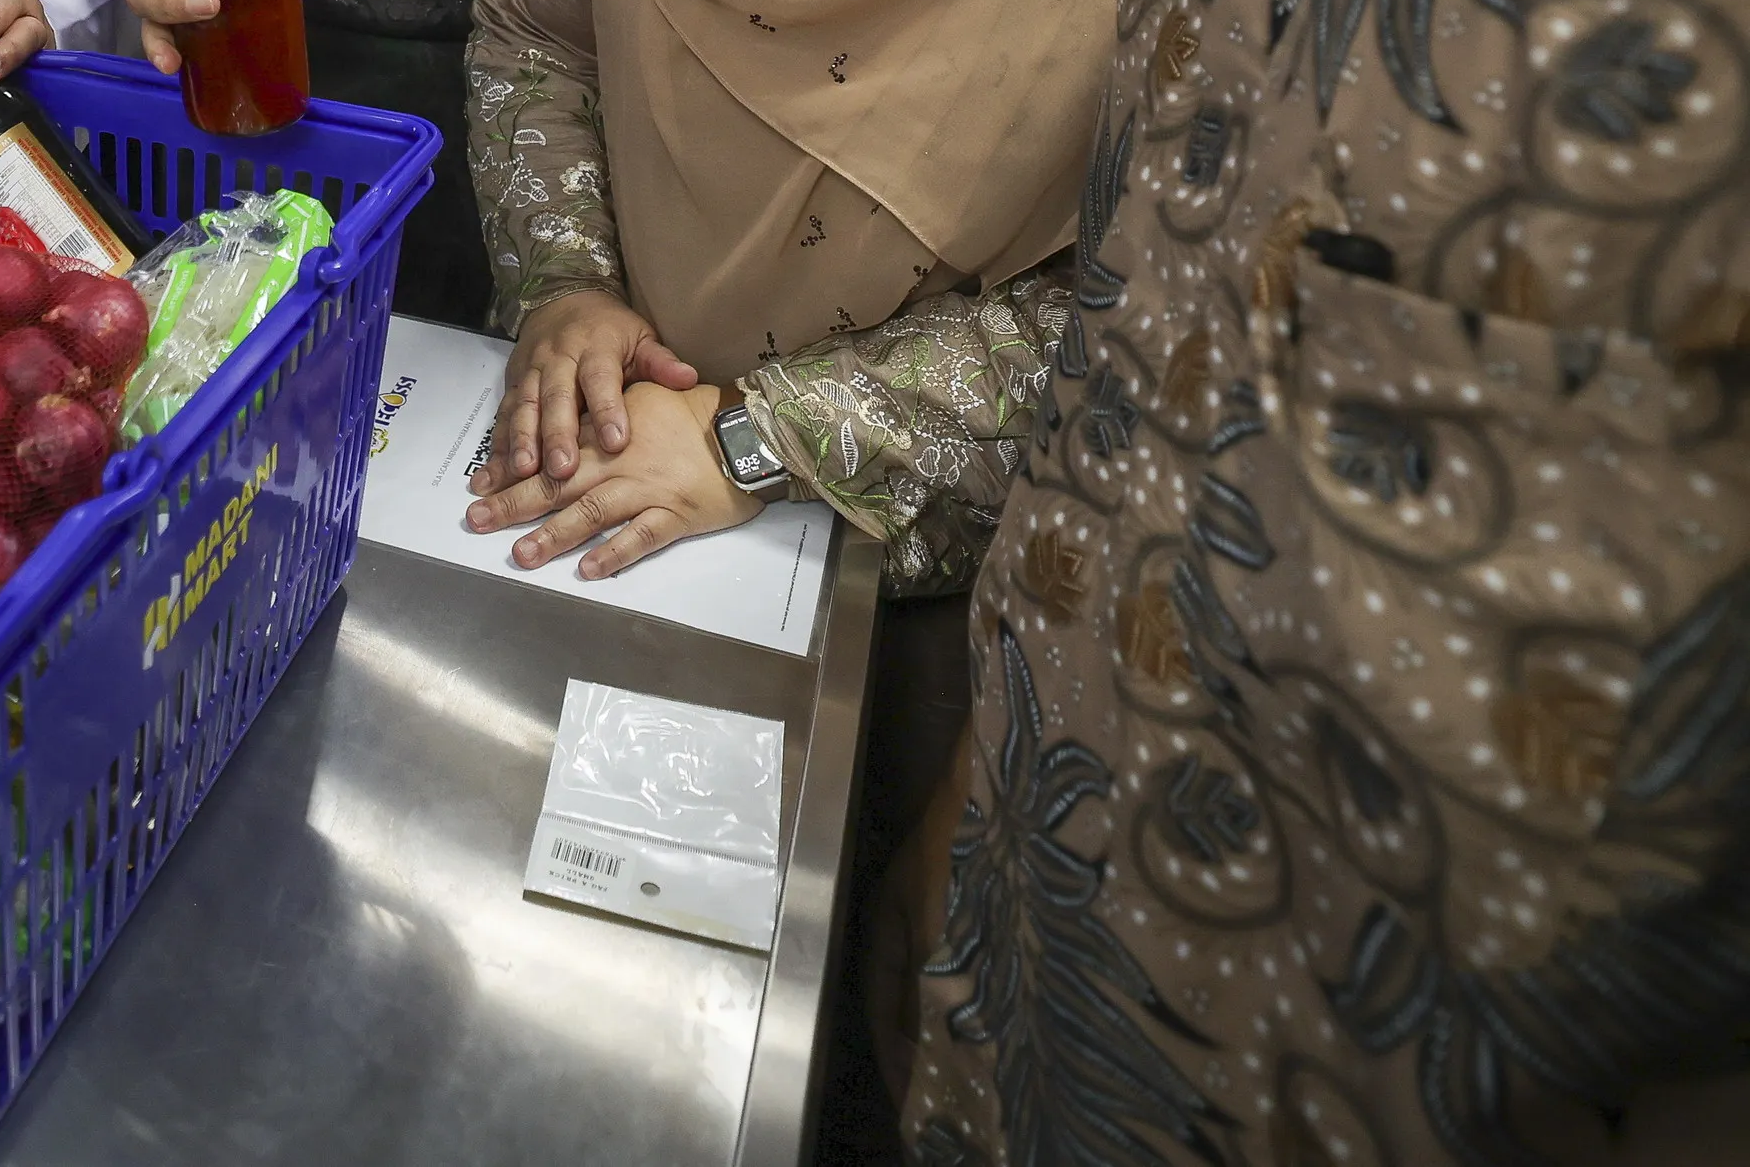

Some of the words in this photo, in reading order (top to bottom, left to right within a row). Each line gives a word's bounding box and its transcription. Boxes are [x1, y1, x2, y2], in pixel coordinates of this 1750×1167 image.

[185, 442, 278, 587] MADANI
[735, 453, 760, 471] 3:06
[184, 508, 254, 624] MART
